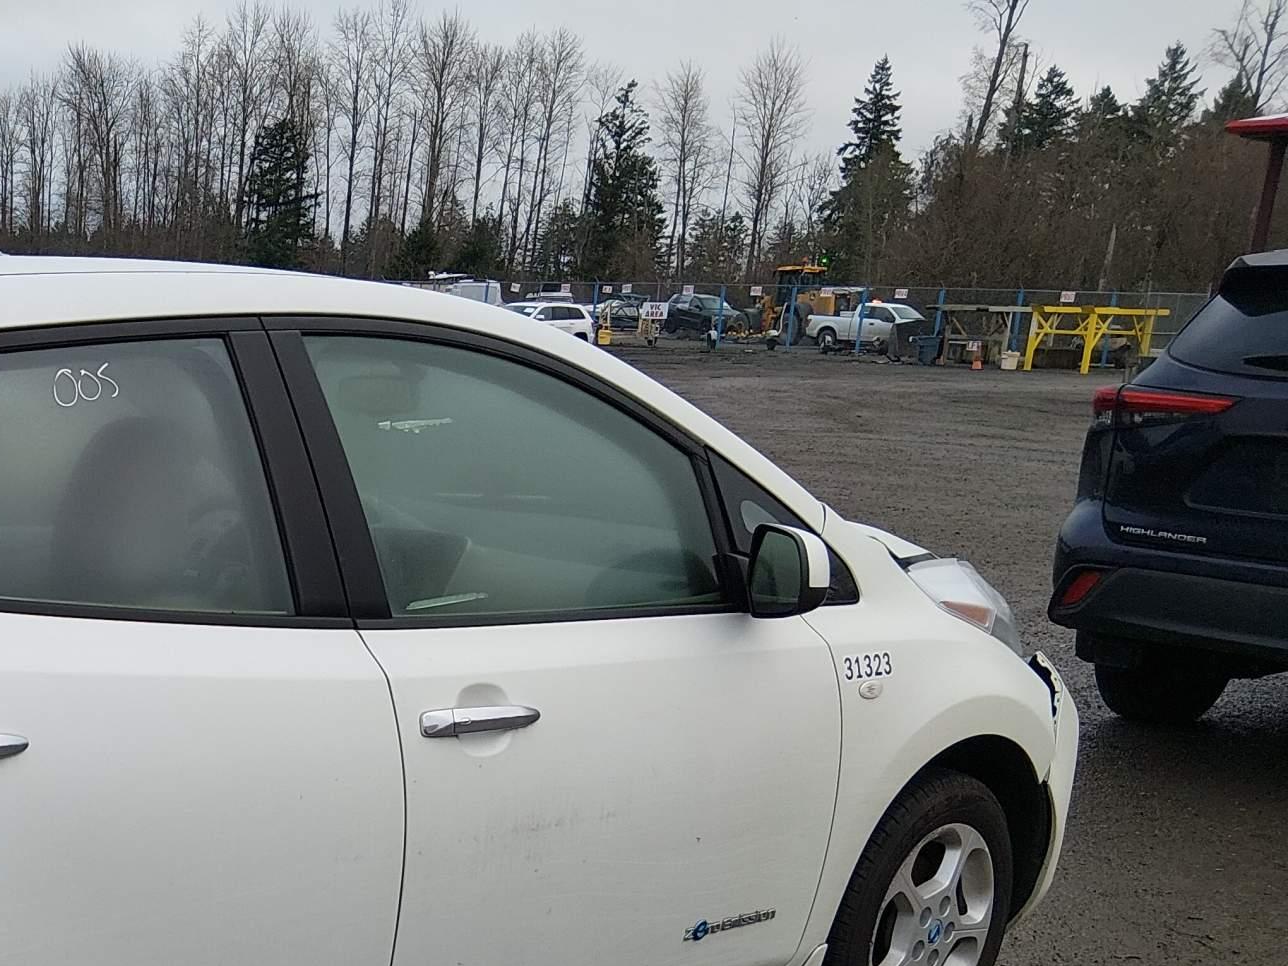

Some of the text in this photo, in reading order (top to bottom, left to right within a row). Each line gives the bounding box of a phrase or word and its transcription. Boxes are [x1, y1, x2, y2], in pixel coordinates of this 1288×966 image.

[649, 303, 662, 311] VIC
[644, 310, 664, 318] AREA
[1119, 525, 1208, 544] HIGHLANDER
[843, 652, 893, 681] 31323
